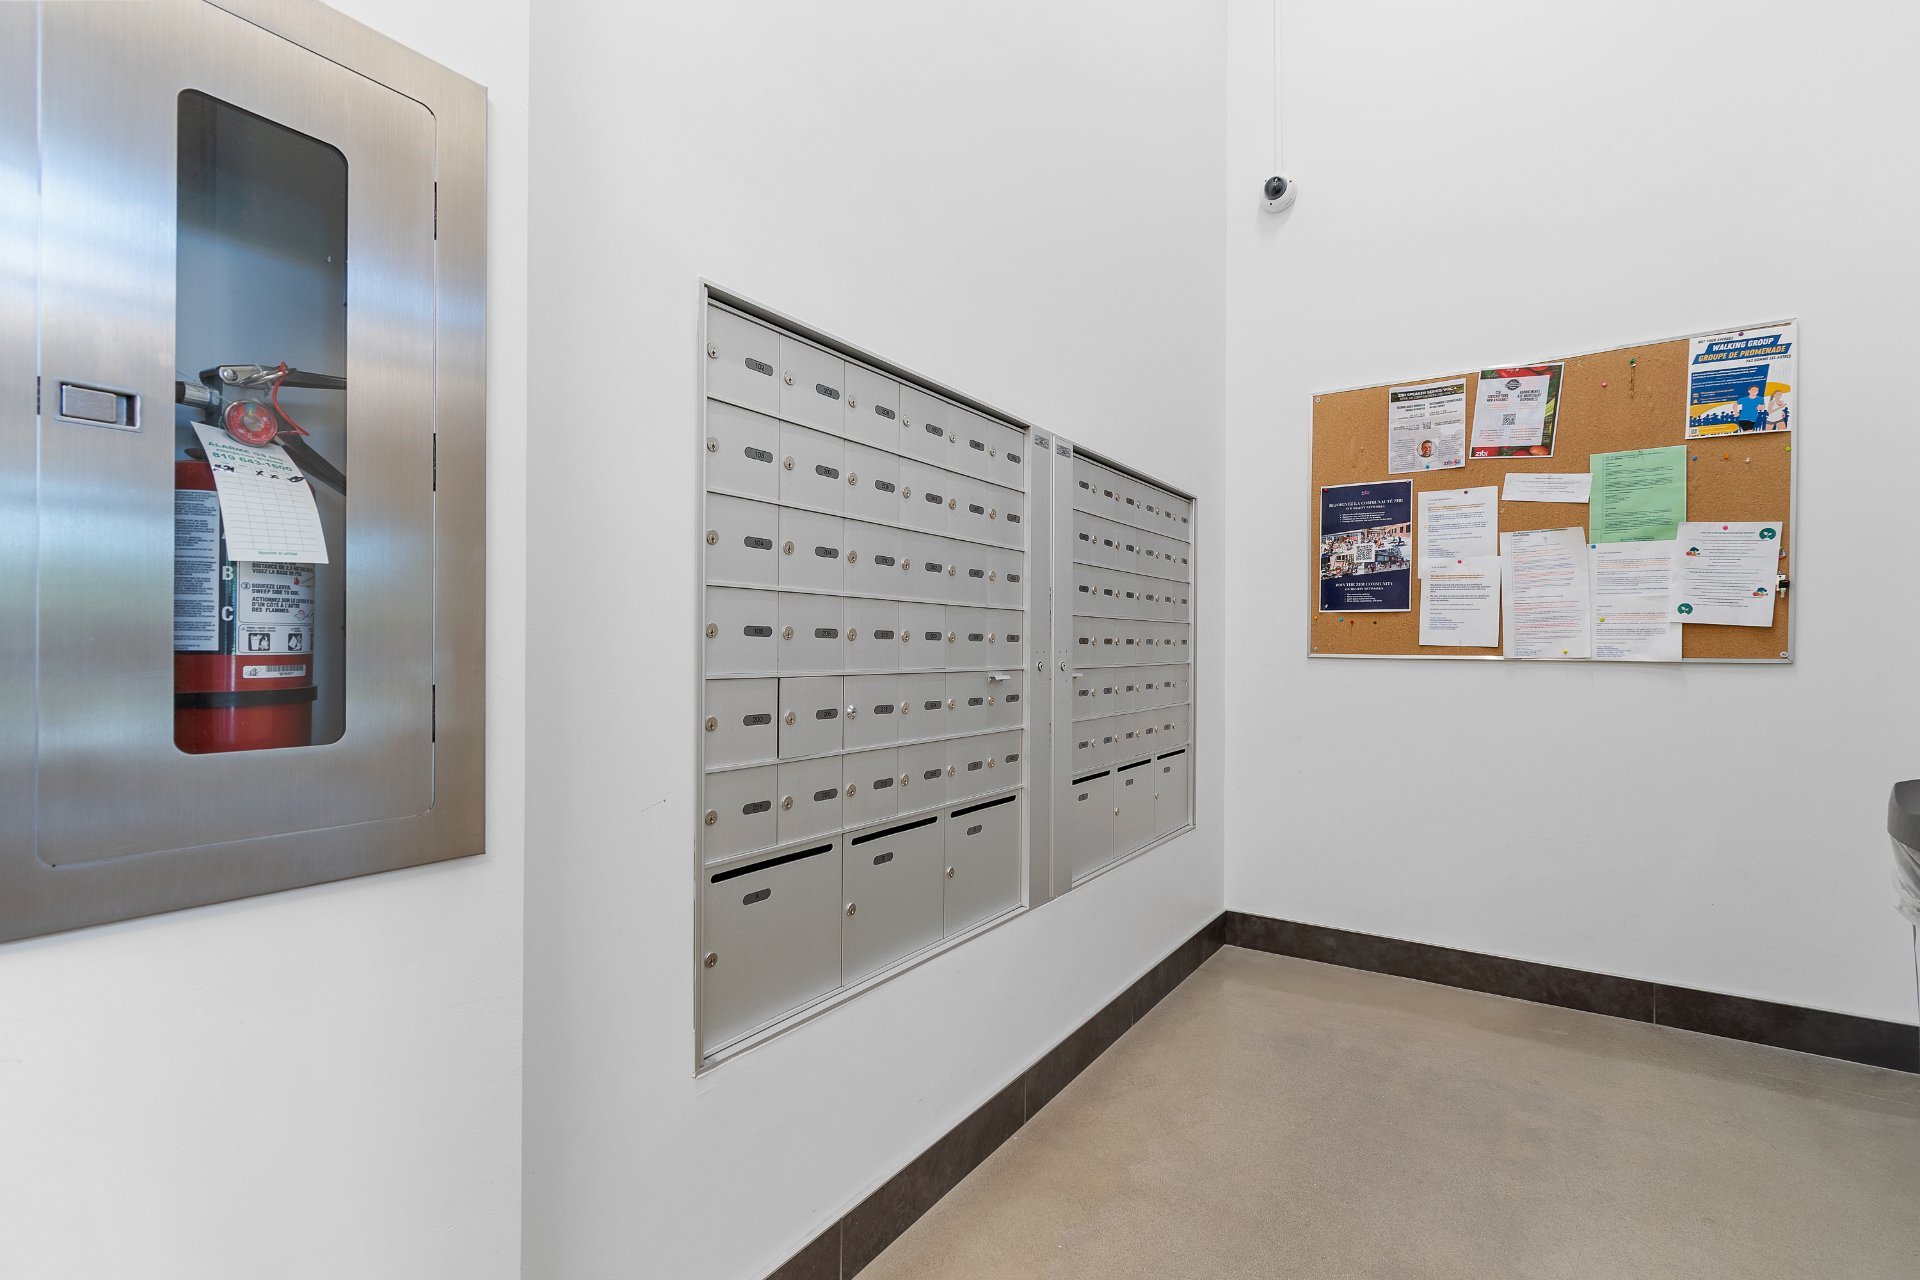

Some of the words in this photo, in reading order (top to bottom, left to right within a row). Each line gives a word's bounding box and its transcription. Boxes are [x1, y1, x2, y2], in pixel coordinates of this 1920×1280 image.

[1713, 342, 1746, 351] WALKING
[1748, 338, 1774, 347] GROUP
[1698, 353, 1727, 362] GROUPE
[1740, 346, 1786, 357] PROMENADE
[755, 362, 764, 371] 102
[823, 387, 832, 395] 202
[208, 442, 250, 454] ALARME
[212, 452, 236, 461] 819
[239, 457, 293, 472] 643-1600
[222, 566, 233, 580] B
[222, 606, 233, 621] C
